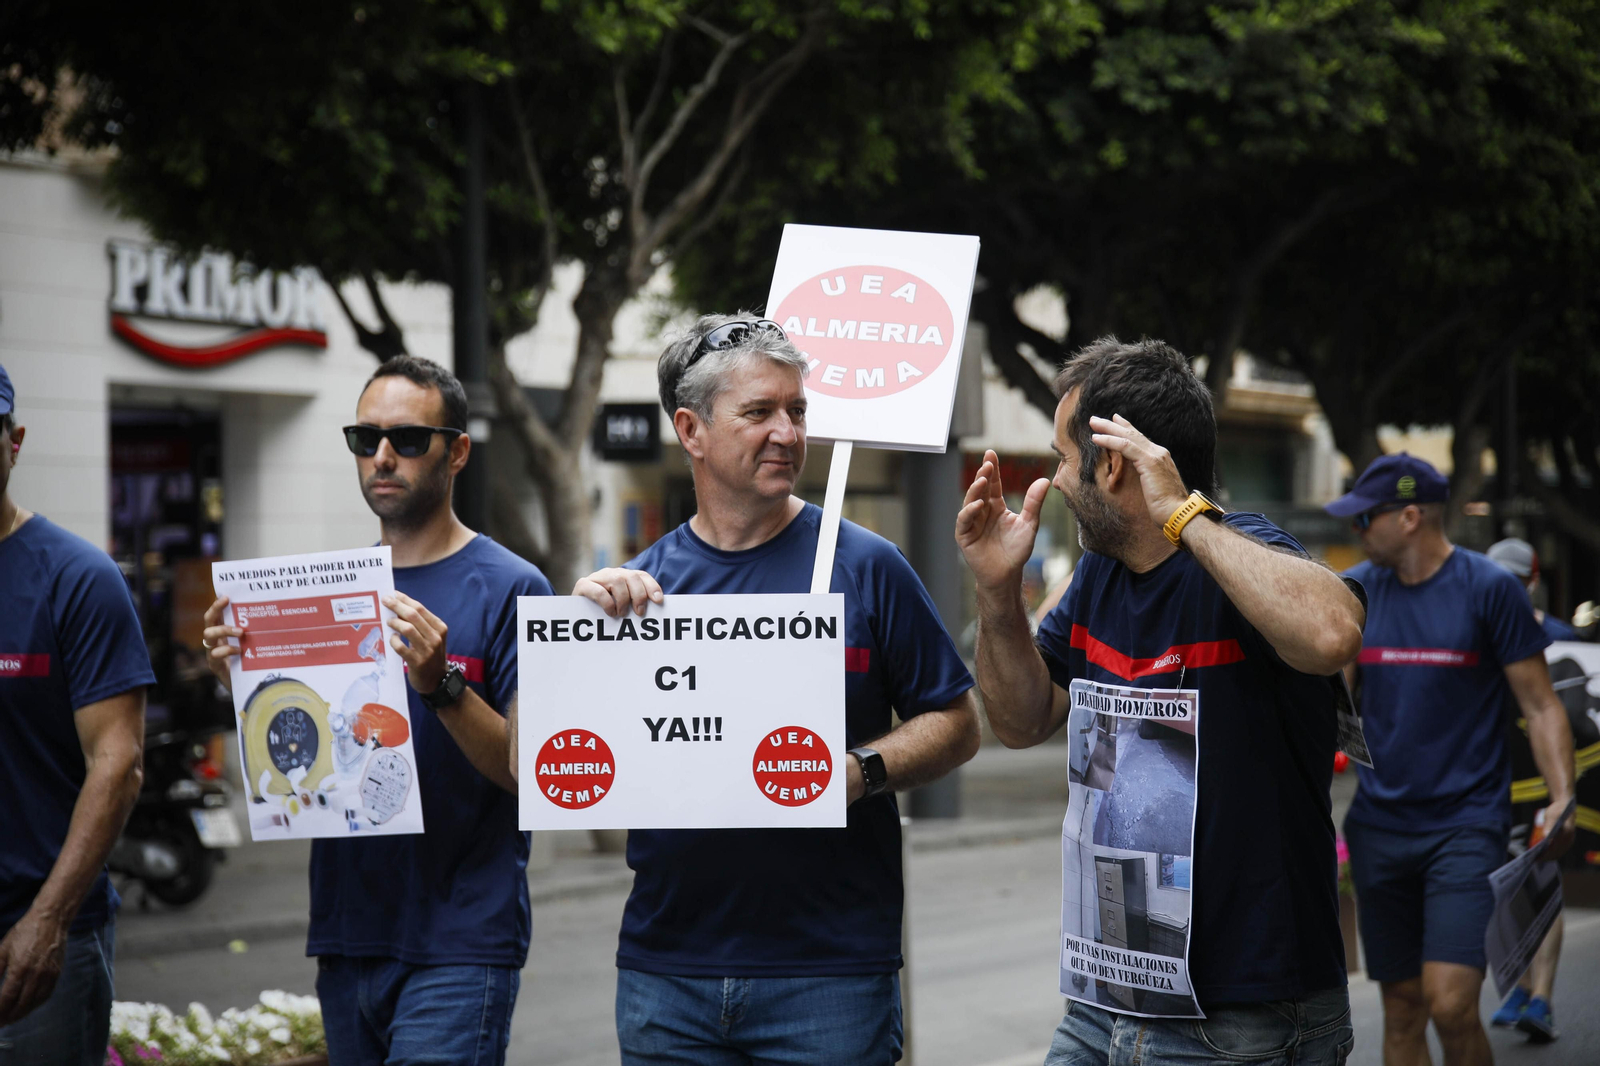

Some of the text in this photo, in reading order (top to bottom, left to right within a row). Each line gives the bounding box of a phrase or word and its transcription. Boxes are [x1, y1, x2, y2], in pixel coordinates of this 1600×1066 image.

[111, 243, 325, 331] PRIMOR
[819, 274, 918, 304] UEA
[783, 315, 944, 346] ALMERIA
[219, 558, 383, 582] SIN MEDIOS PARA PODER HACER
[249, 572, 357, 591] UNA RCP DE CALIDAD
[238, 613, 248, 627] 5
[281, 606, 318, 615] ESENCIALES
[526, 611, 837, 642] RECLASIFICACIÓN
[654, 665, 697, 691] C1
[642, 717, 723, 742] YA!!!
[769, 731, 814, 748] UEA
[552, 734, 597, 751] UEA
[538, 762, 612, 776] ALMERIA
[756, 760, 829, 773] ALMERIA
[546, 783, 606, 803] UEMA
[764, 780, 822, 800] UEMA
[1066, 938, 1178, 975] POR UNAS INSTALACIONES
[1070, 956, 1174, 991] QUE NO DEN VERGÜEZA
